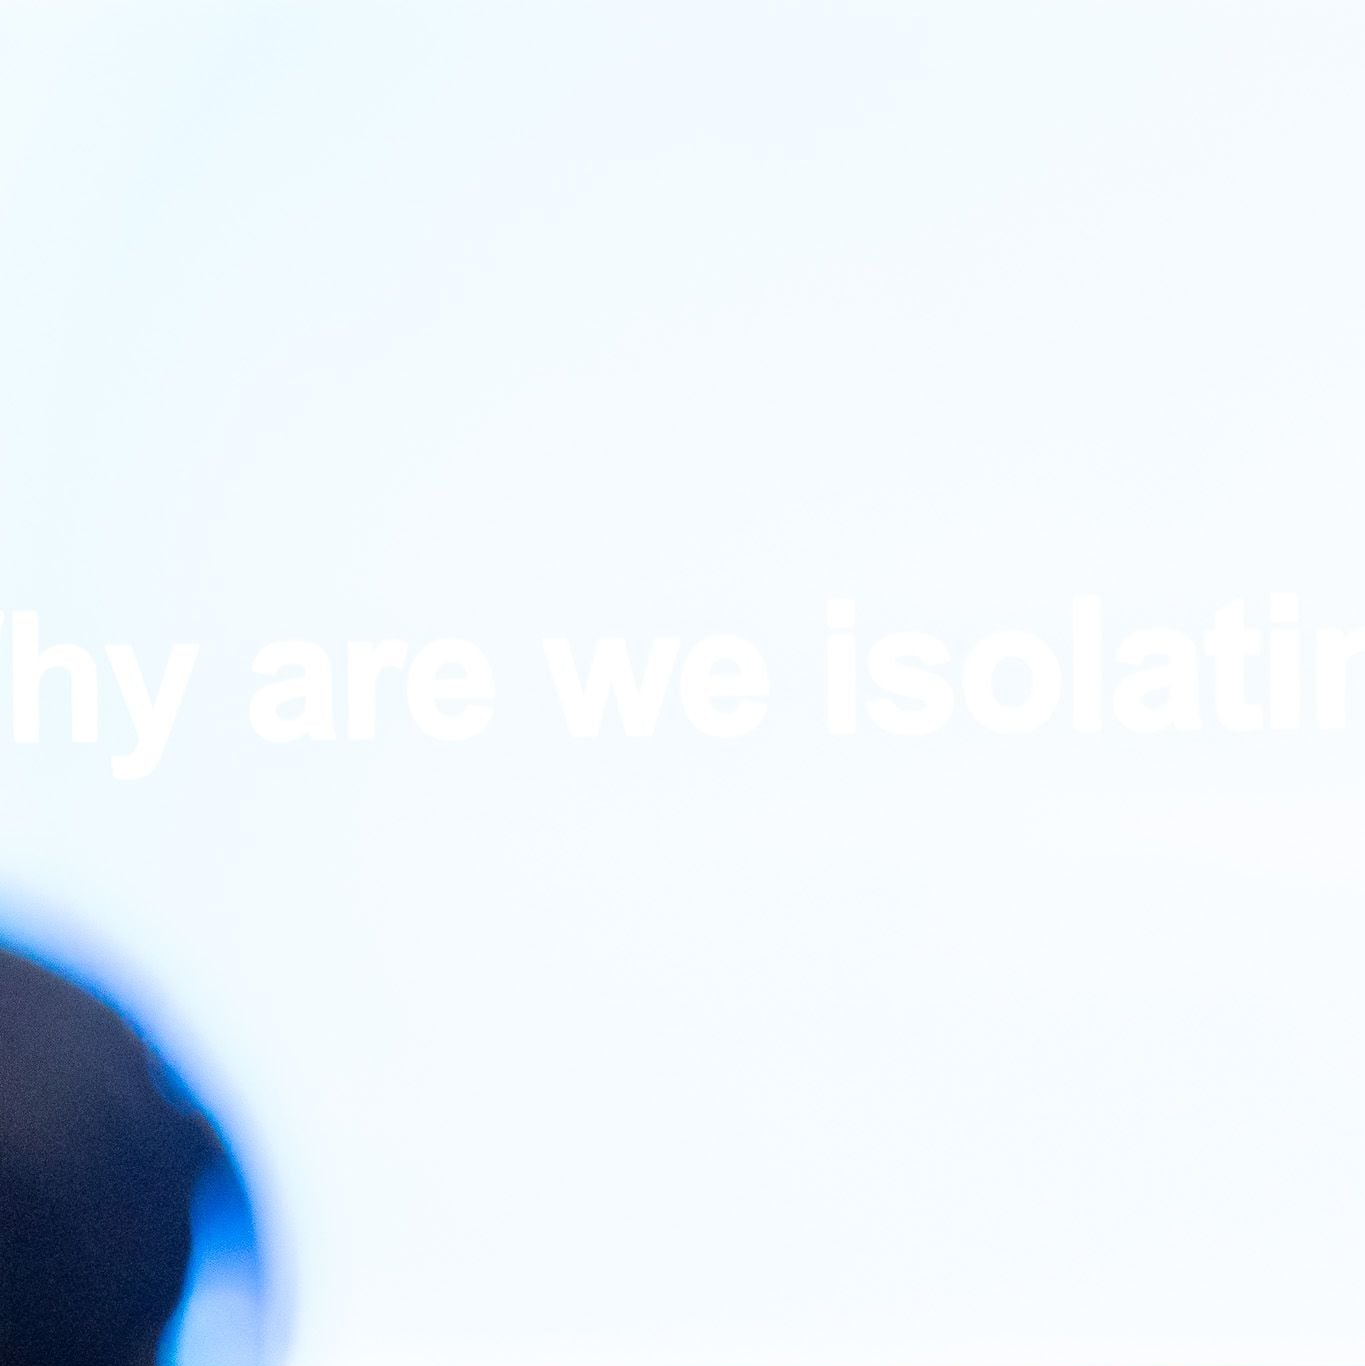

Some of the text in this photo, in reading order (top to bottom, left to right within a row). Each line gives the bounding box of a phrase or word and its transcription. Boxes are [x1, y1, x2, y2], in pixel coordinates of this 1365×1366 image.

[0, 607, 197, 780] hy
[248, 637, 497, 742] are
[542, 632, 770, 739] we
